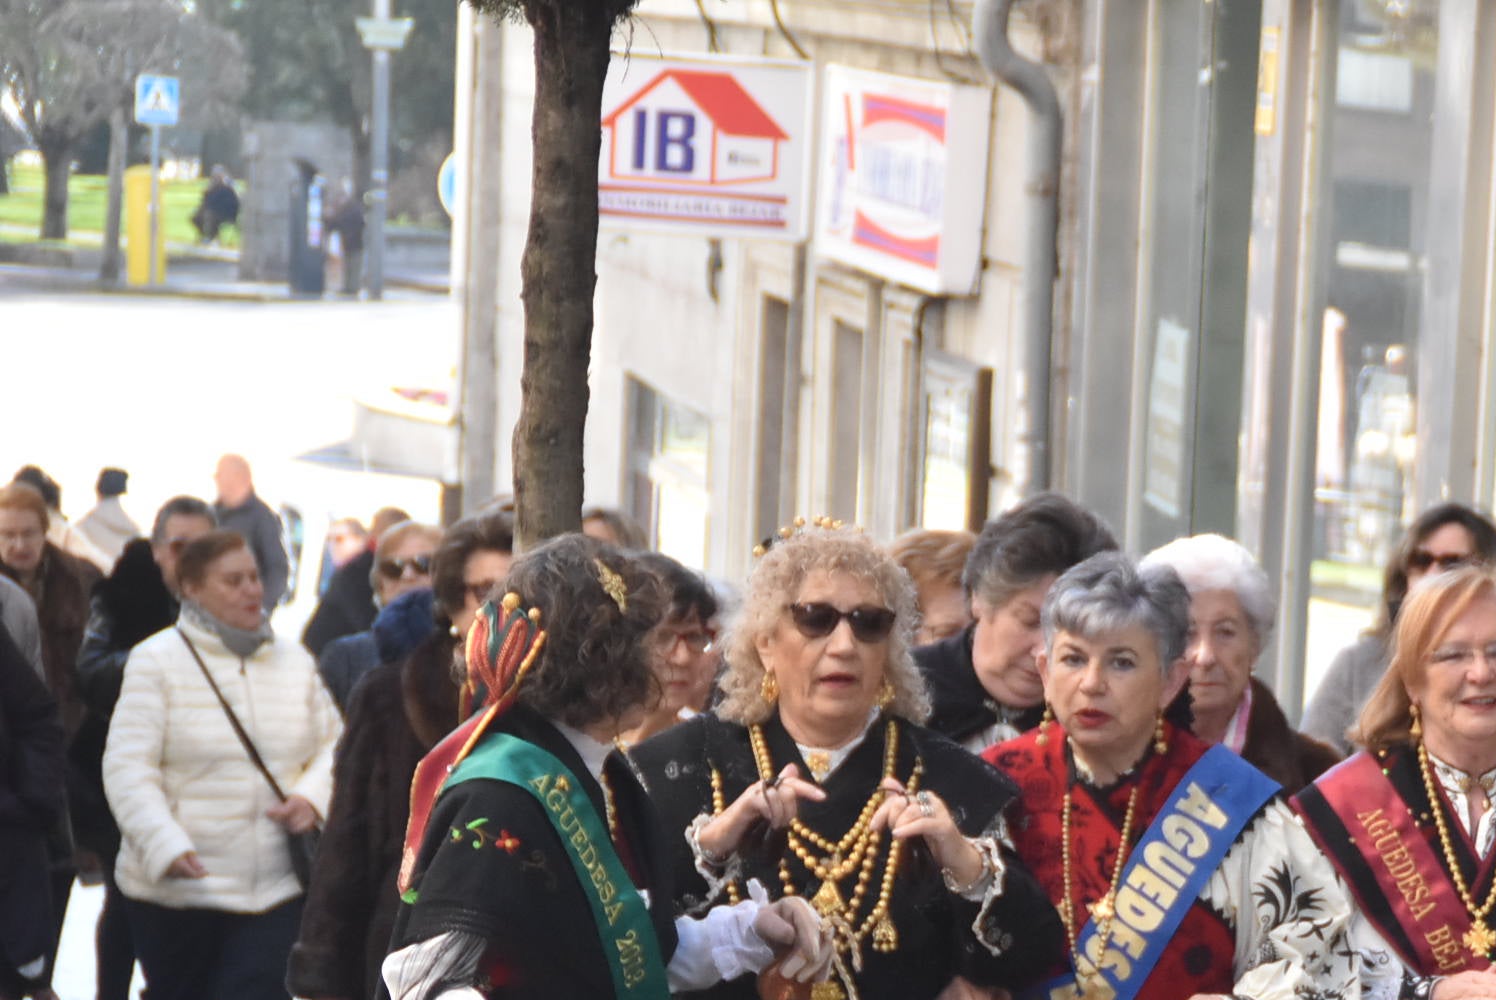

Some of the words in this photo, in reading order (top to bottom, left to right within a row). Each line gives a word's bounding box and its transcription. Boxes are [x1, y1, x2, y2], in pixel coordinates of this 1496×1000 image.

[633, 110, 695, 171] IB
[528, 774, 624, 926] AGUEDESA
[1356, 808, 1437, 922] AGUEDESA
